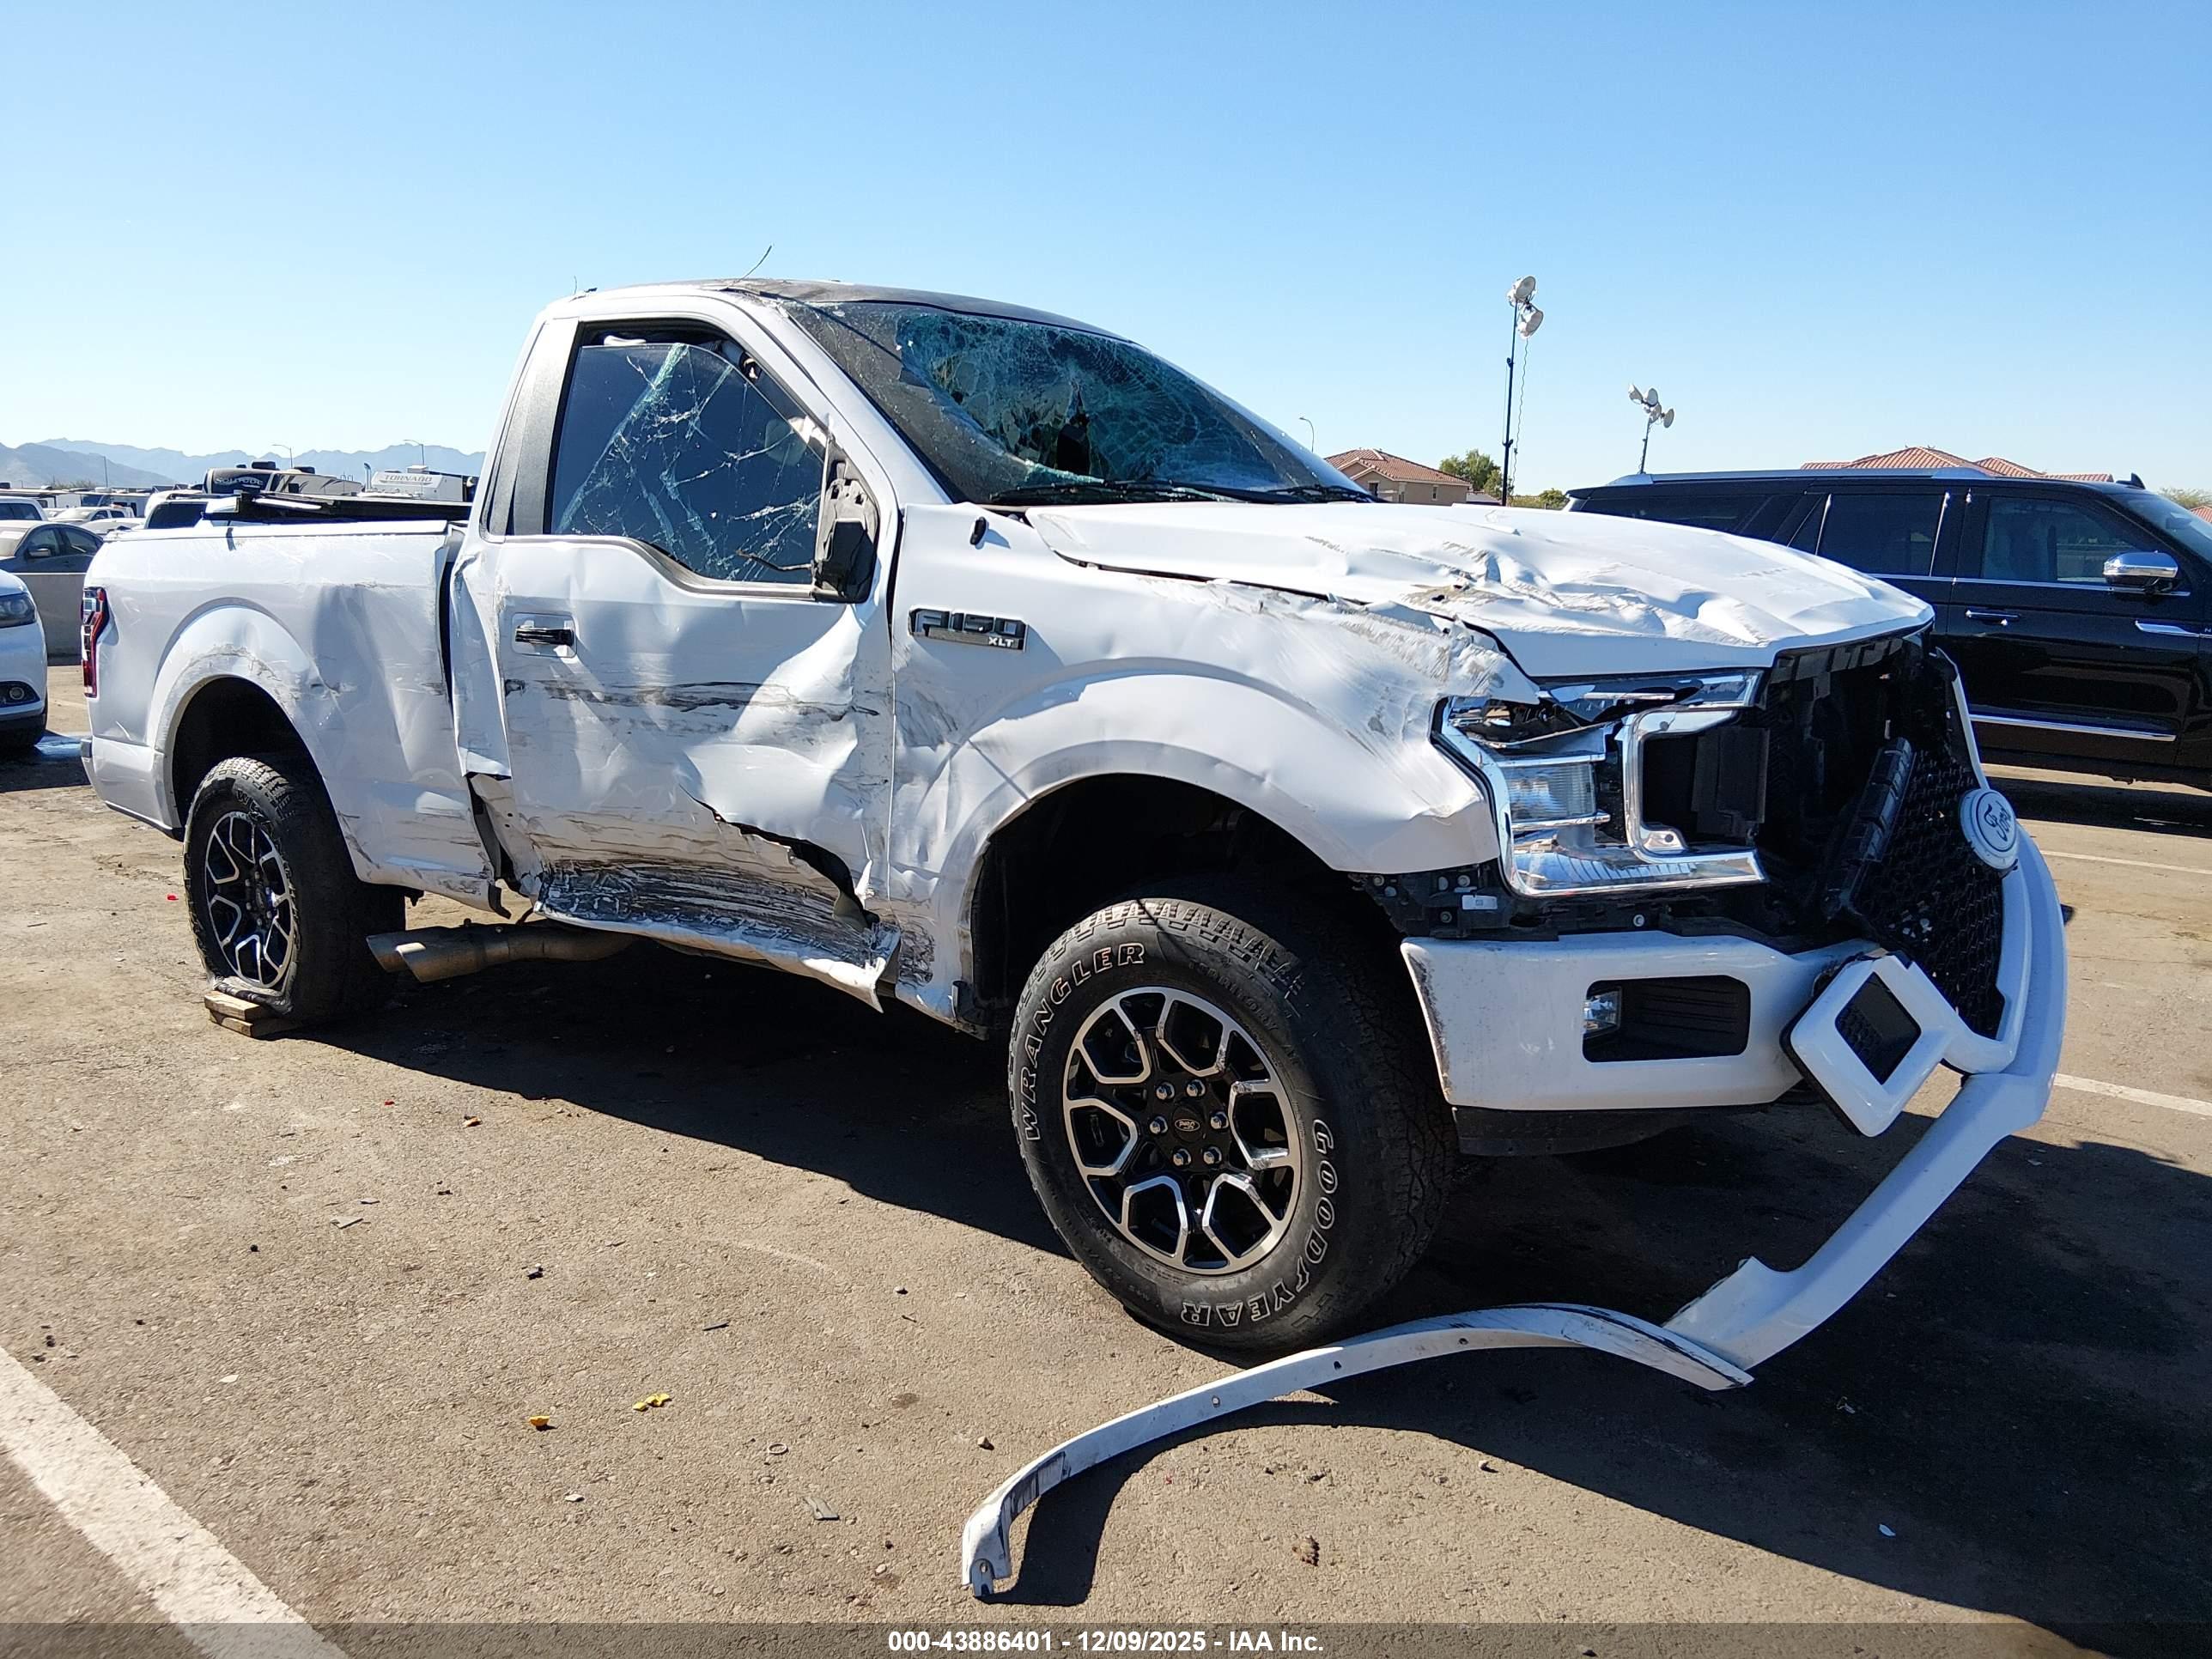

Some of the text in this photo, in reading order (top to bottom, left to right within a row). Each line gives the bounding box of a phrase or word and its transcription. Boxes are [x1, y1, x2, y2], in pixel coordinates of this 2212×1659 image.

[988, 636, 1014, 647] XLT
[1984, 800, 2012, 842] Ford
[1020, 942, 1146, 1140] WRANGLER
[1180, 1119, 1339, 1327] GOODYEAR
